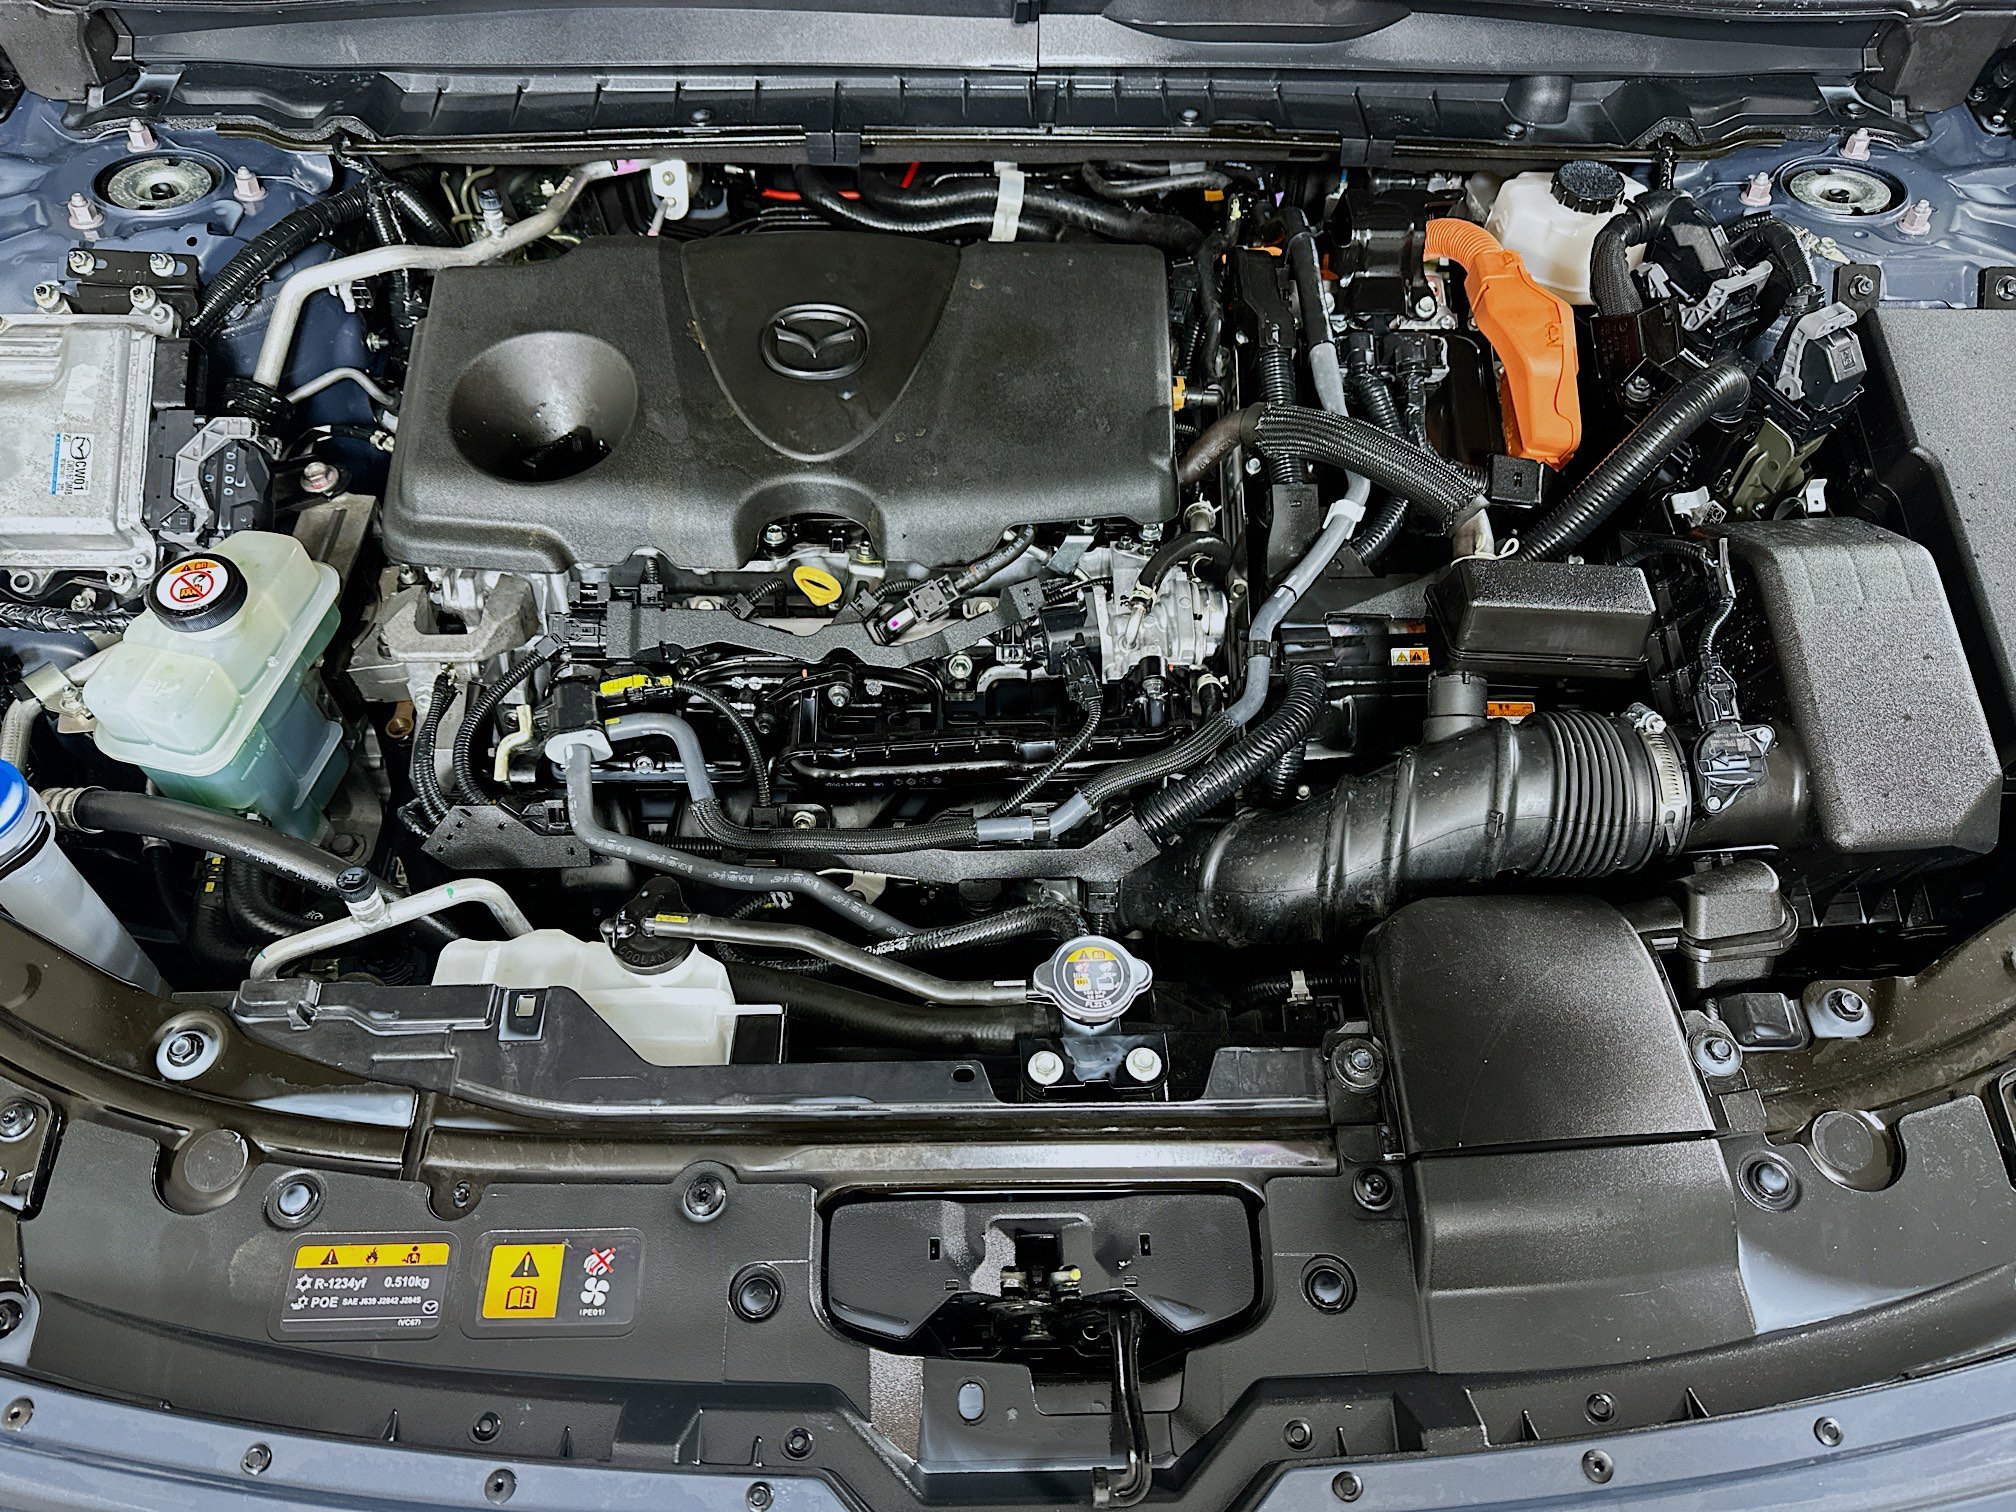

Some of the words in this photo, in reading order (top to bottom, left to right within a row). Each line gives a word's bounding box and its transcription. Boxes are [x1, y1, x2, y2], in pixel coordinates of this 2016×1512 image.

[74, 461, 86, 490] CW01
[618, 946, 673, 965] COOLANT
[314, 1277, 368, 1291] R-1234yf
[384, 1276, 430, 1290] 0.510kg
[310, 1297, 339, 1308] POE
[342, 1297, 359, 1306] SAE
[359, 1297, 377, 1305] J639
[579, 1308, 605, 1317] (PE01)
